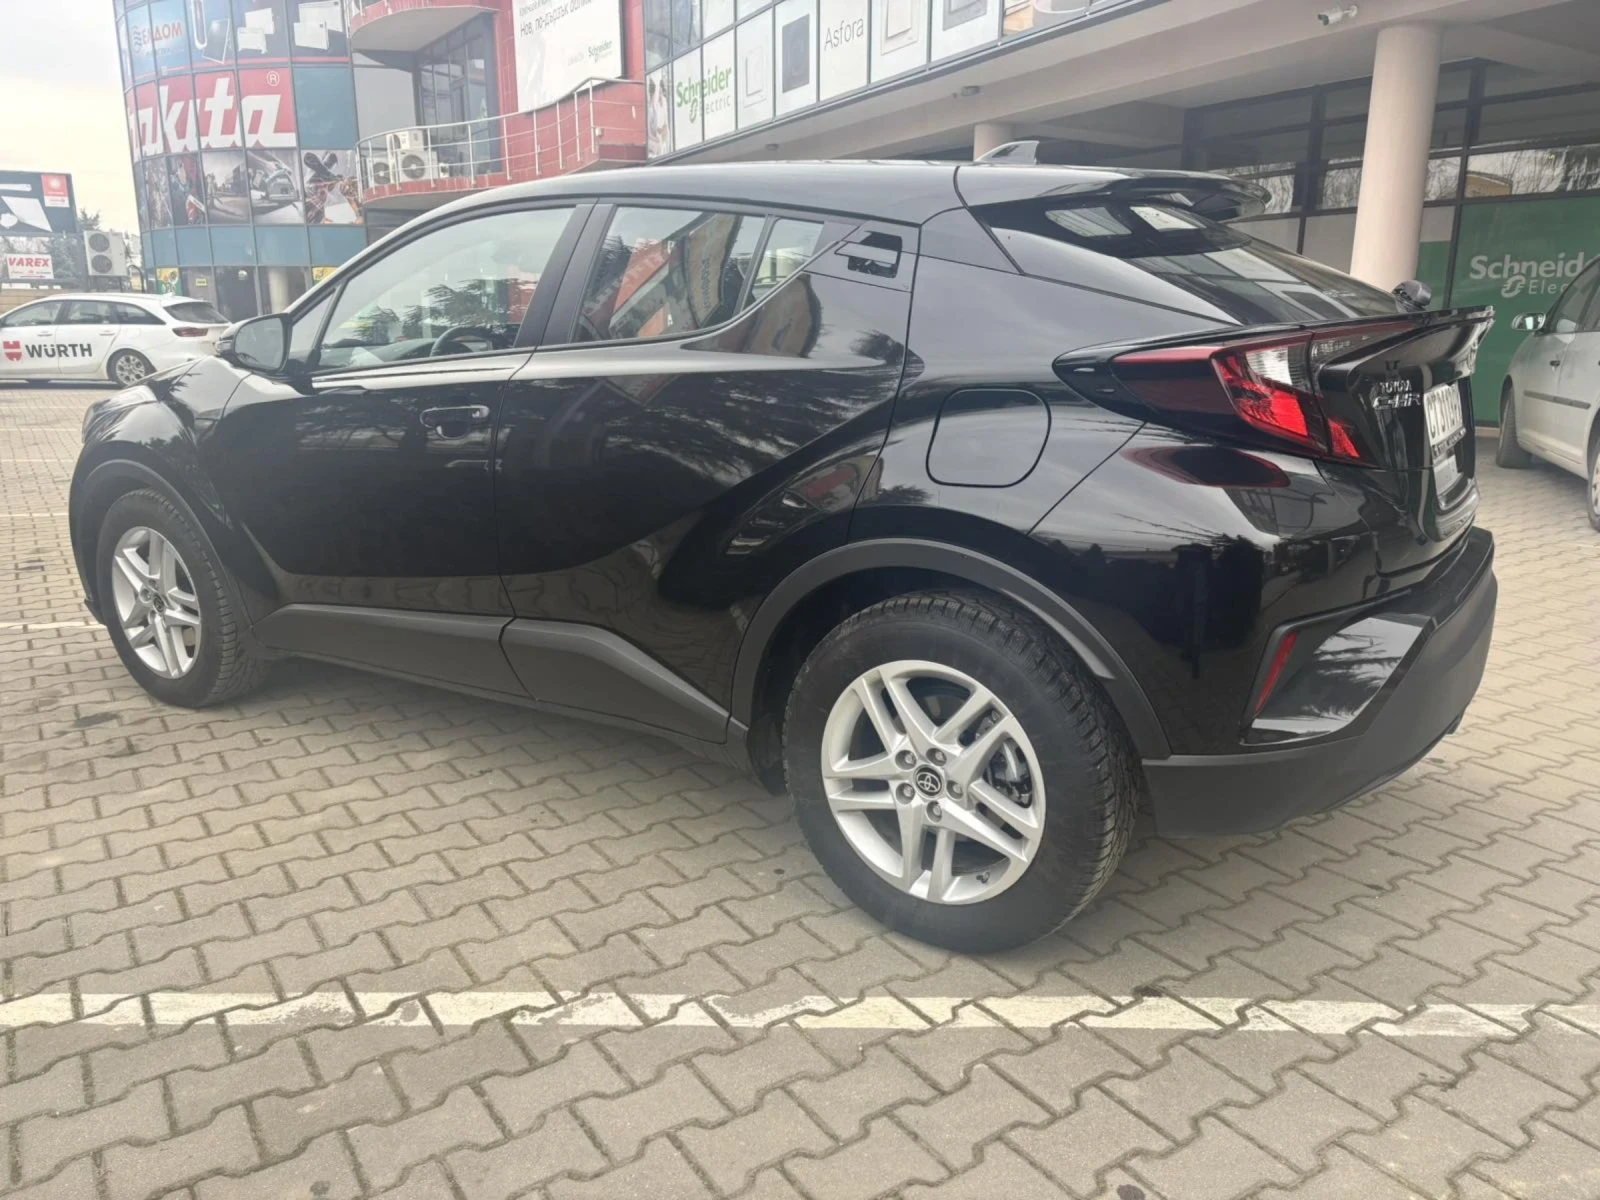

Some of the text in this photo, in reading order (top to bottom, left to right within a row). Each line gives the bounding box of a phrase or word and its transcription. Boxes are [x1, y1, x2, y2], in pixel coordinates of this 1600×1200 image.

[824, 18, 864, 51] Asfora
[676, 66, 732, 108] Schneider
[8, 257, 49, 268] VAREX
[1469, 251, 1590, 280] Schneid
[25, 343, 93, 358] WÜRTH
[1380, 380, 1412, 393] TOYOTA
